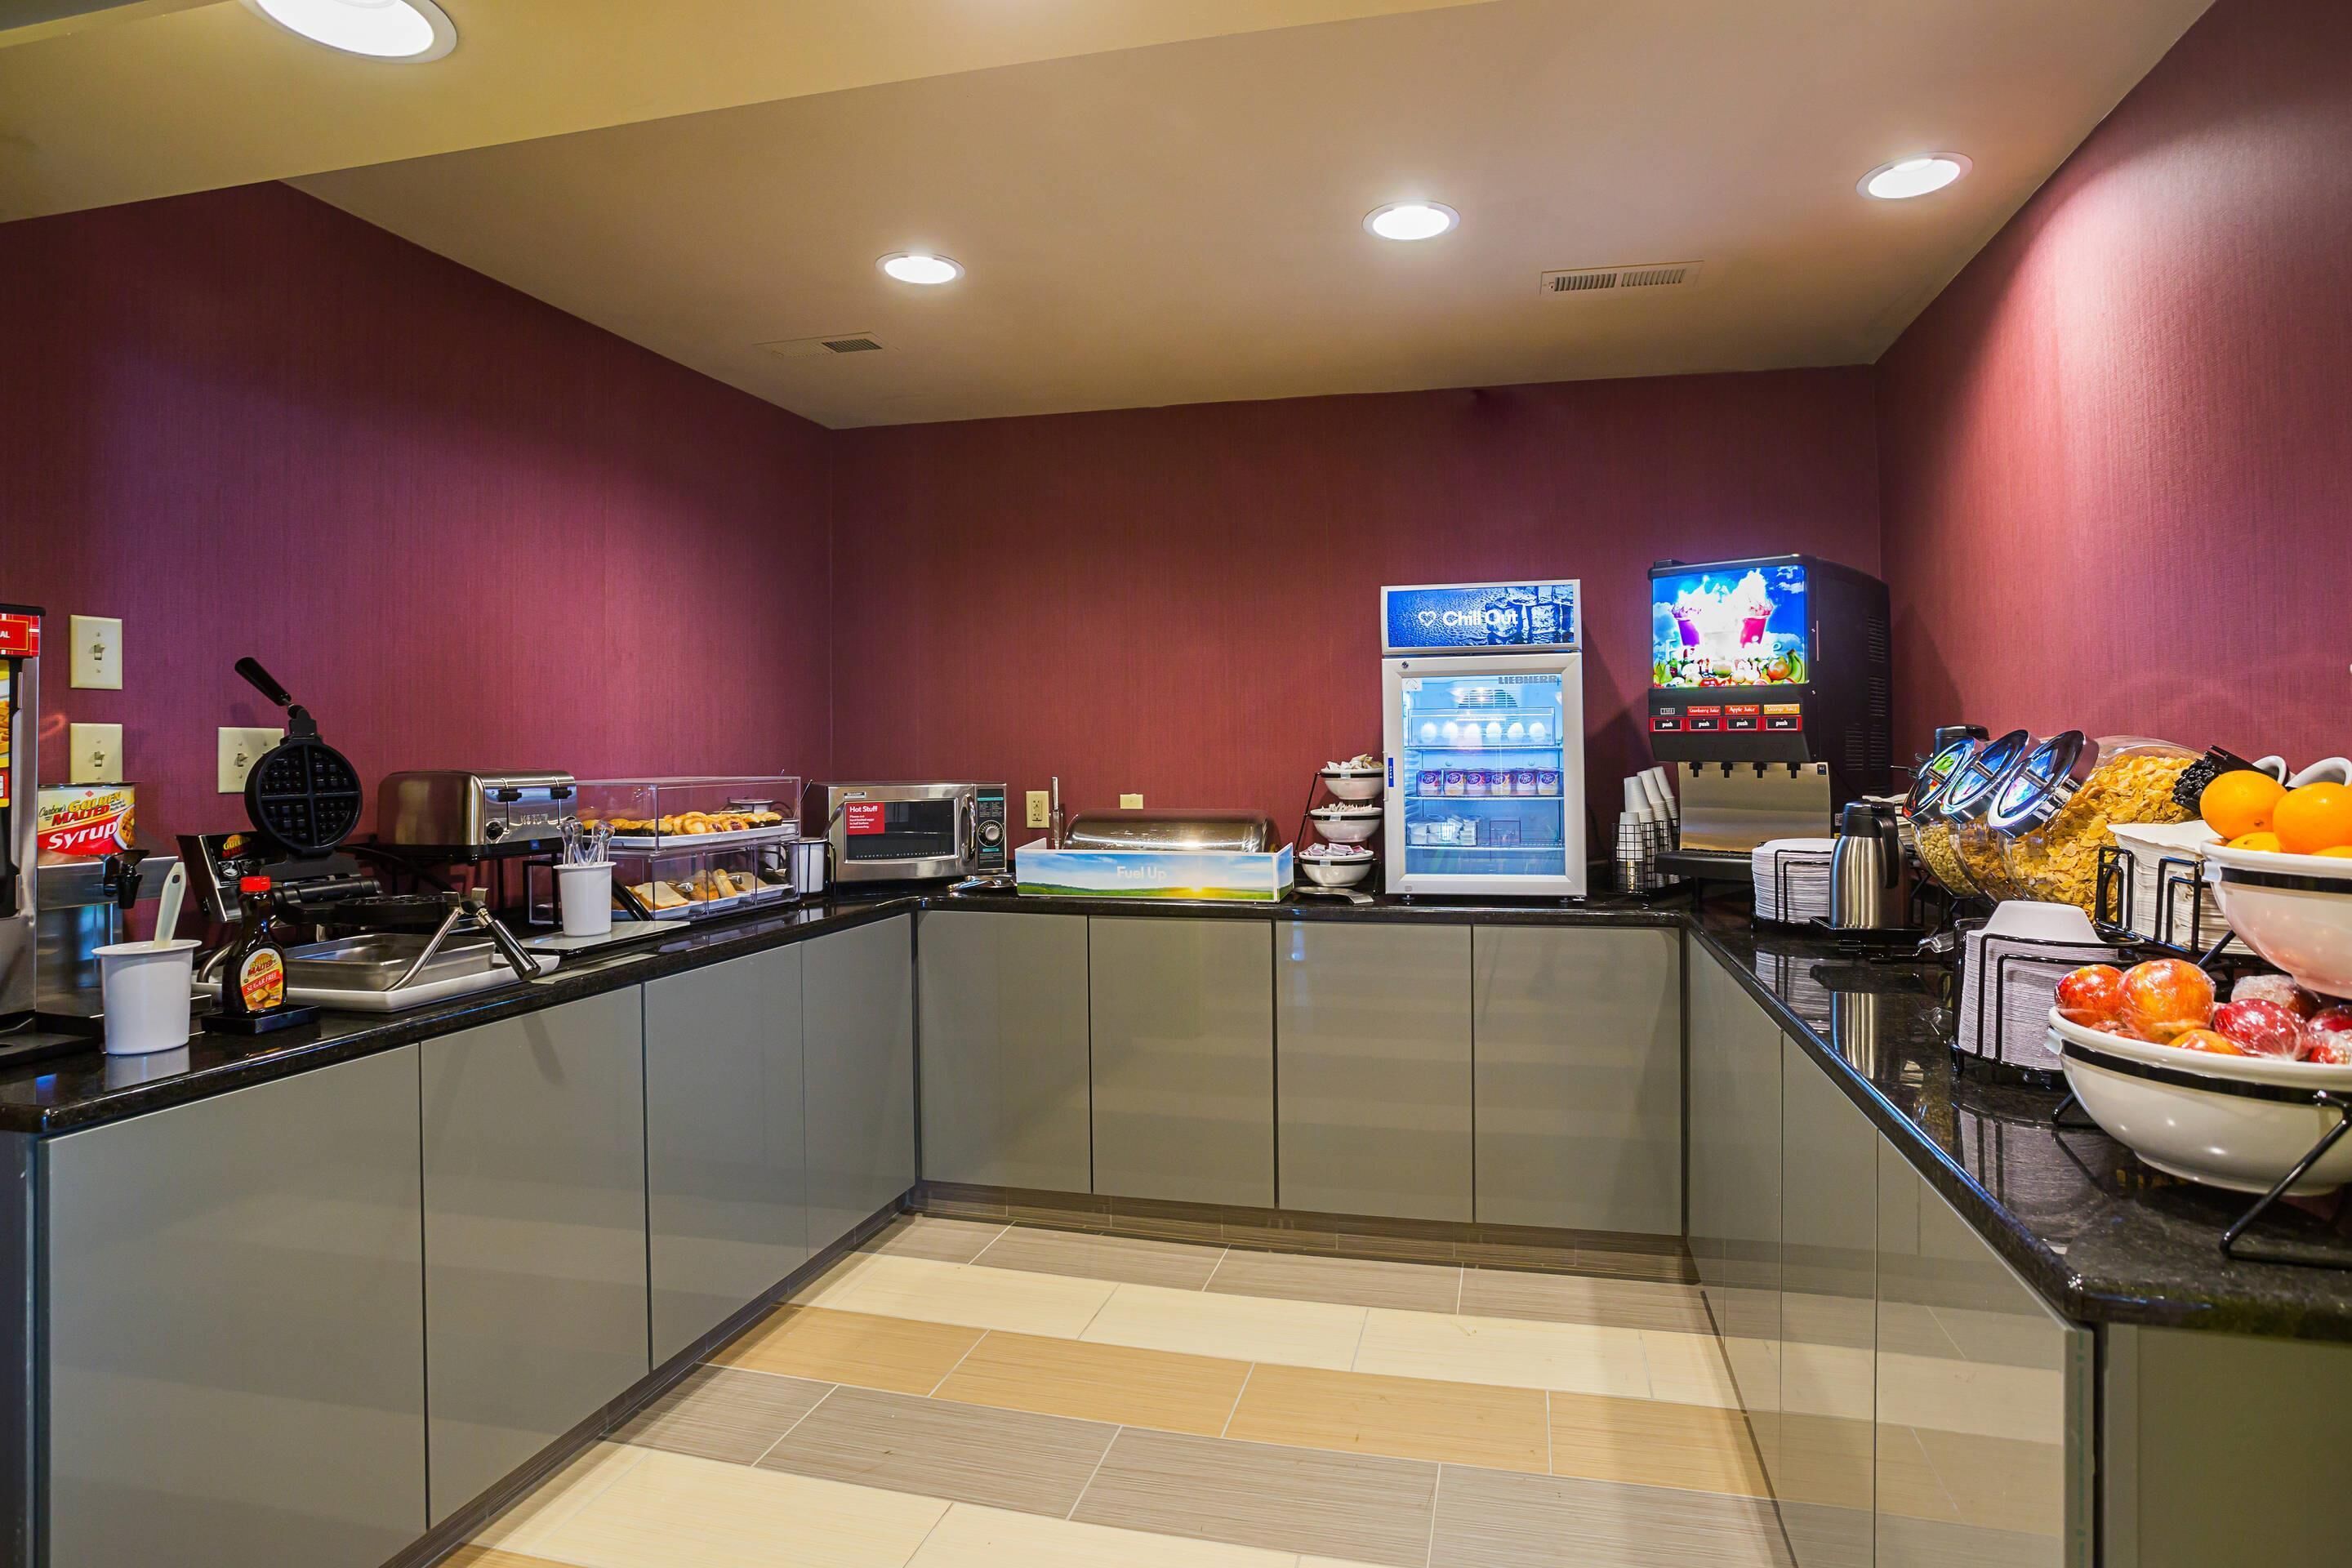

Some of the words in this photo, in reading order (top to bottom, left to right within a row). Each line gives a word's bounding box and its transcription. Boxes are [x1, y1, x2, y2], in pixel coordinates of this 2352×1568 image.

[1443, 611, 1481, 626] Chill
[1486, 609, 1518, 626] Out
[1498, 675, 1557, 684] LIEBHERR
[67, 791, 122, 813] GOLDEN
[51, 804, 110, 827] MALTED
[47, 821, 118, 850] Syrup
[1116, 866, 1144, 879] Fuel
[1147, 866, 1167, 886] Up
[265, 972, 277, 982] FREE
